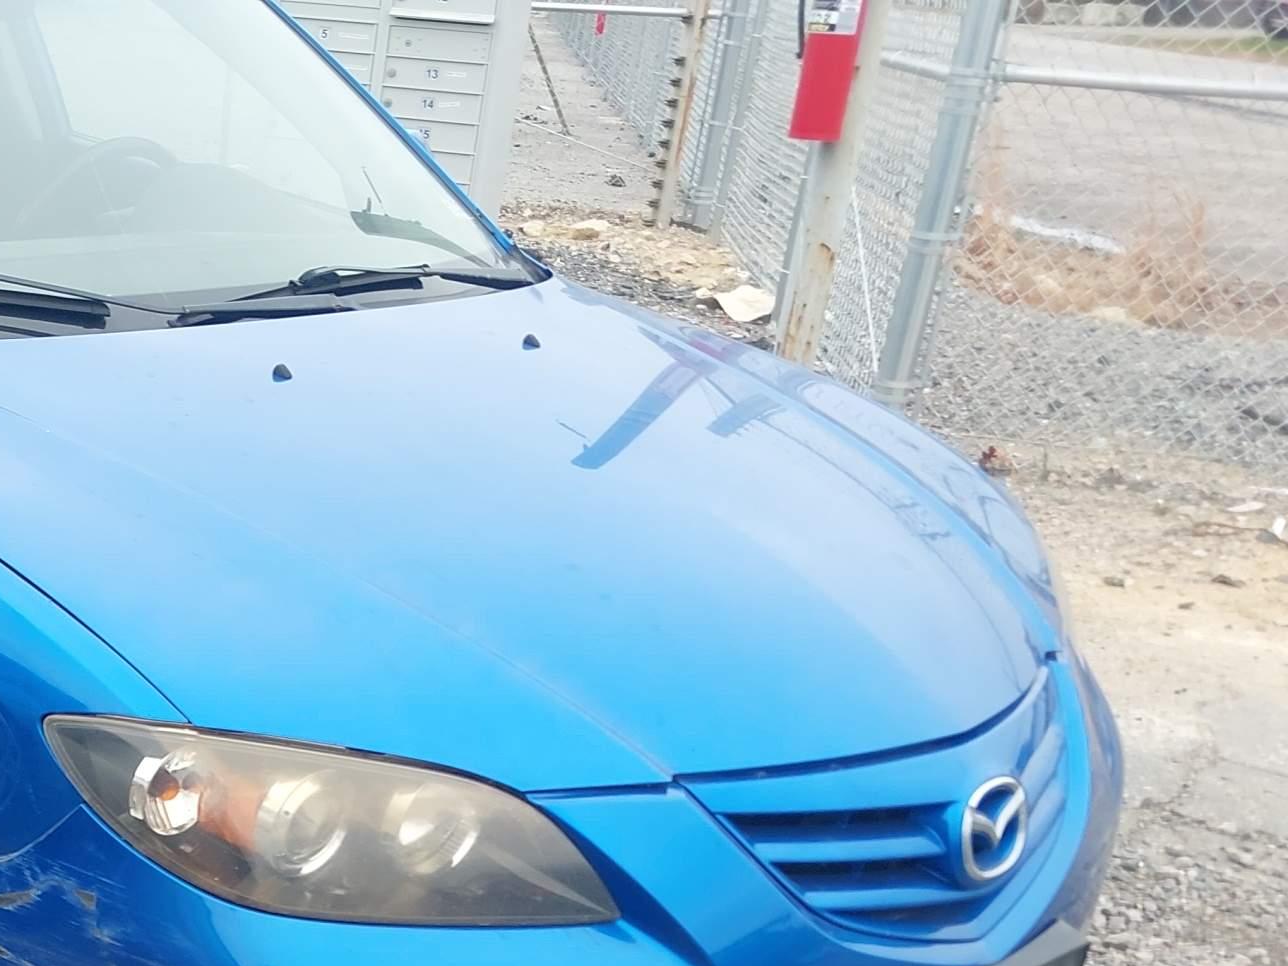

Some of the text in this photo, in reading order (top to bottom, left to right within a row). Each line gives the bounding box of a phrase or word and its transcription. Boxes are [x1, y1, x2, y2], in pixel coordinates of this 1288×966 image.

[321, 29, 329, 39] 5
[426, 69, 439, 80] 13
[422, 99, 434, 109] 14
[419, 129, 430, 140] 5
